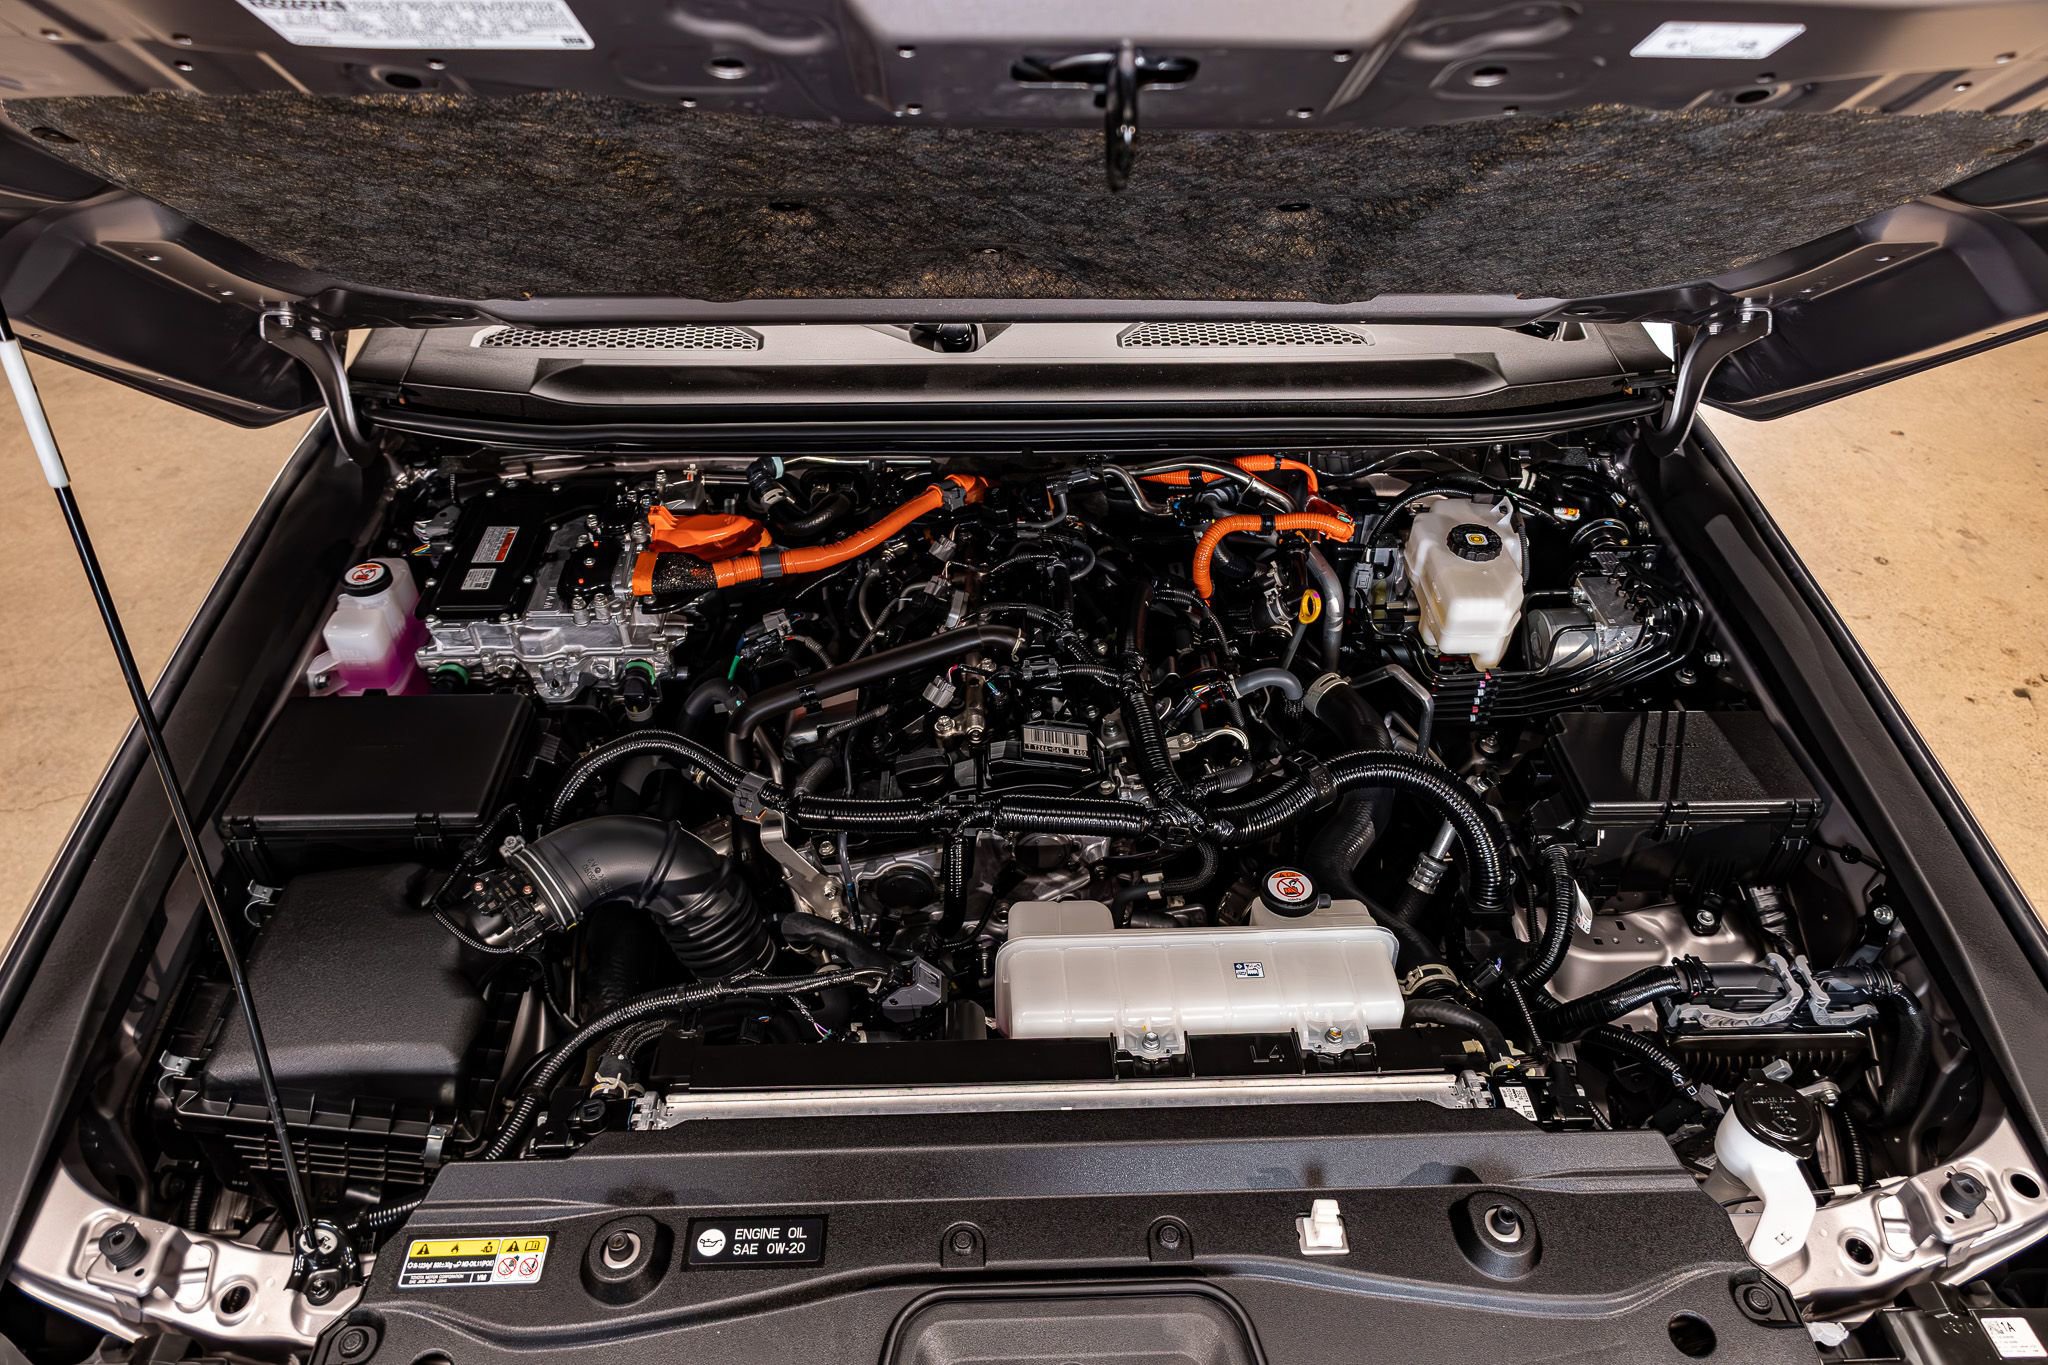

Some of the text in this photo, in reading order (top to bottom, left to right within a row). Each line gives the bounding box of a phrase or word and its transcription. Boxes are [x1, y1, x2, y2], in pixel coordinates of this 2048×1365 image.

[734, 1226, 808, 1240] ENGINE OIL
[732, 1242, 806, 1256] SAE 0W-20
